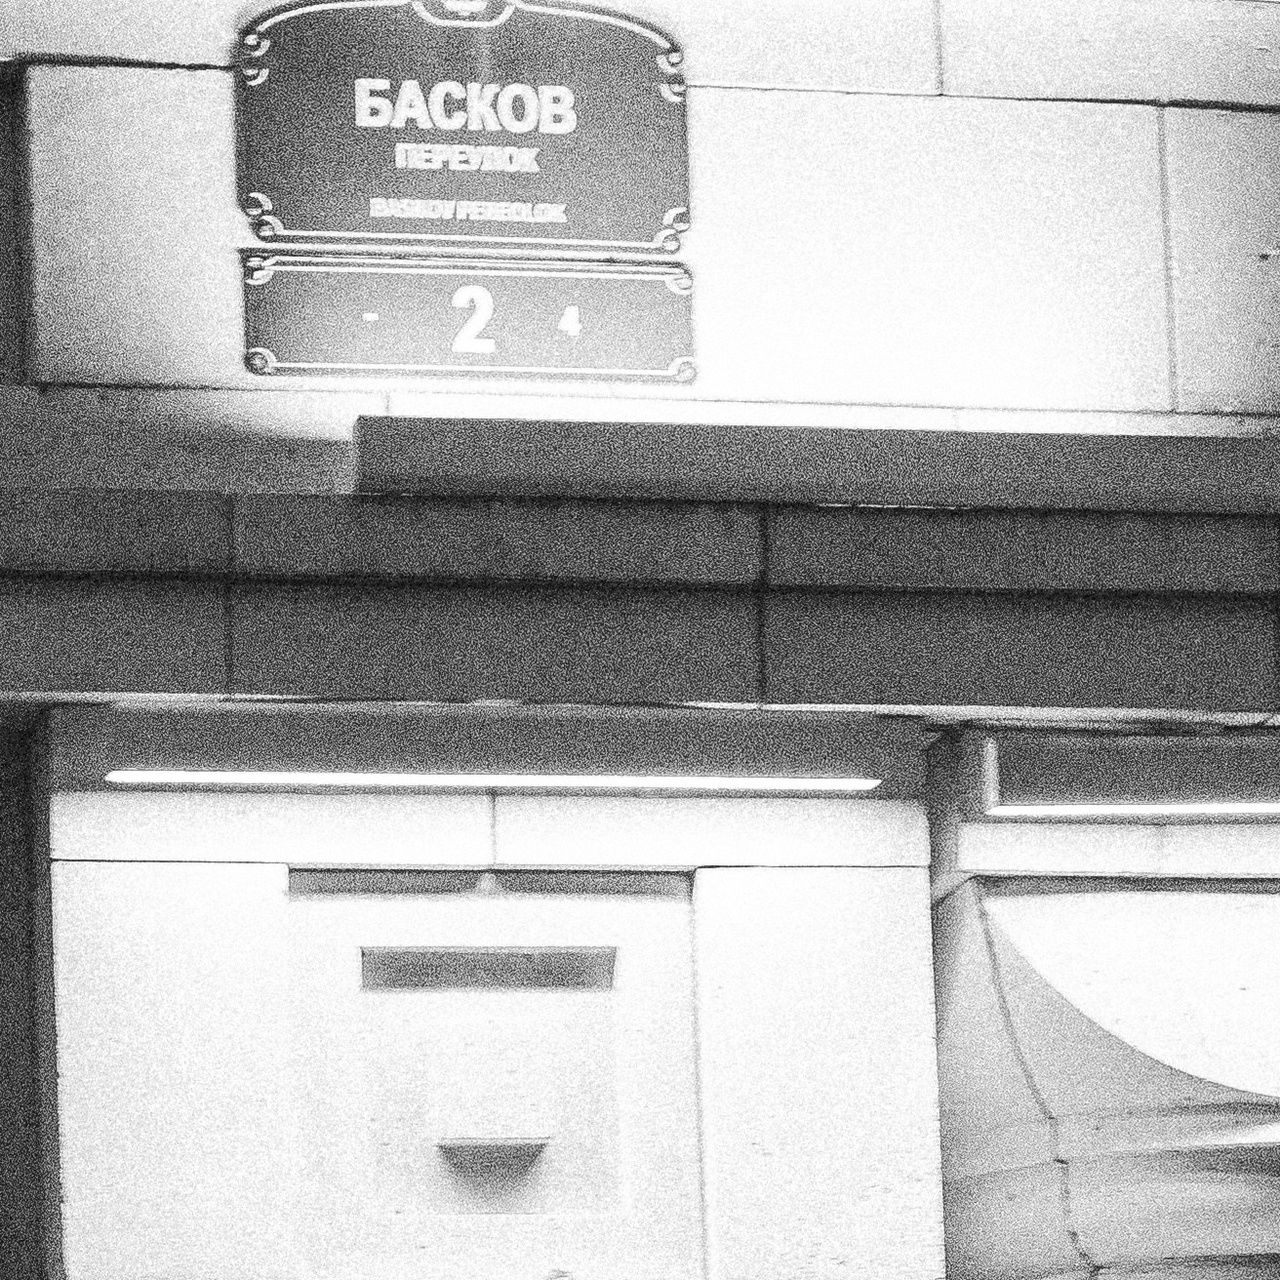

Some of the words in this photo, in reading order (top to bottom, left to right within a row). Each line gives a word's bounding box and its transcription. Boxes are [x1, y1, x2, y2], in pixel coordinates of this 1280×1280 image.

[354, 77, 578, 135] БАСКОВ
[394, 141, 541, 173] ПЕРЕУЛОК
[451, 284, 496, 354] 2
[557, 304, 583, 337] 4
